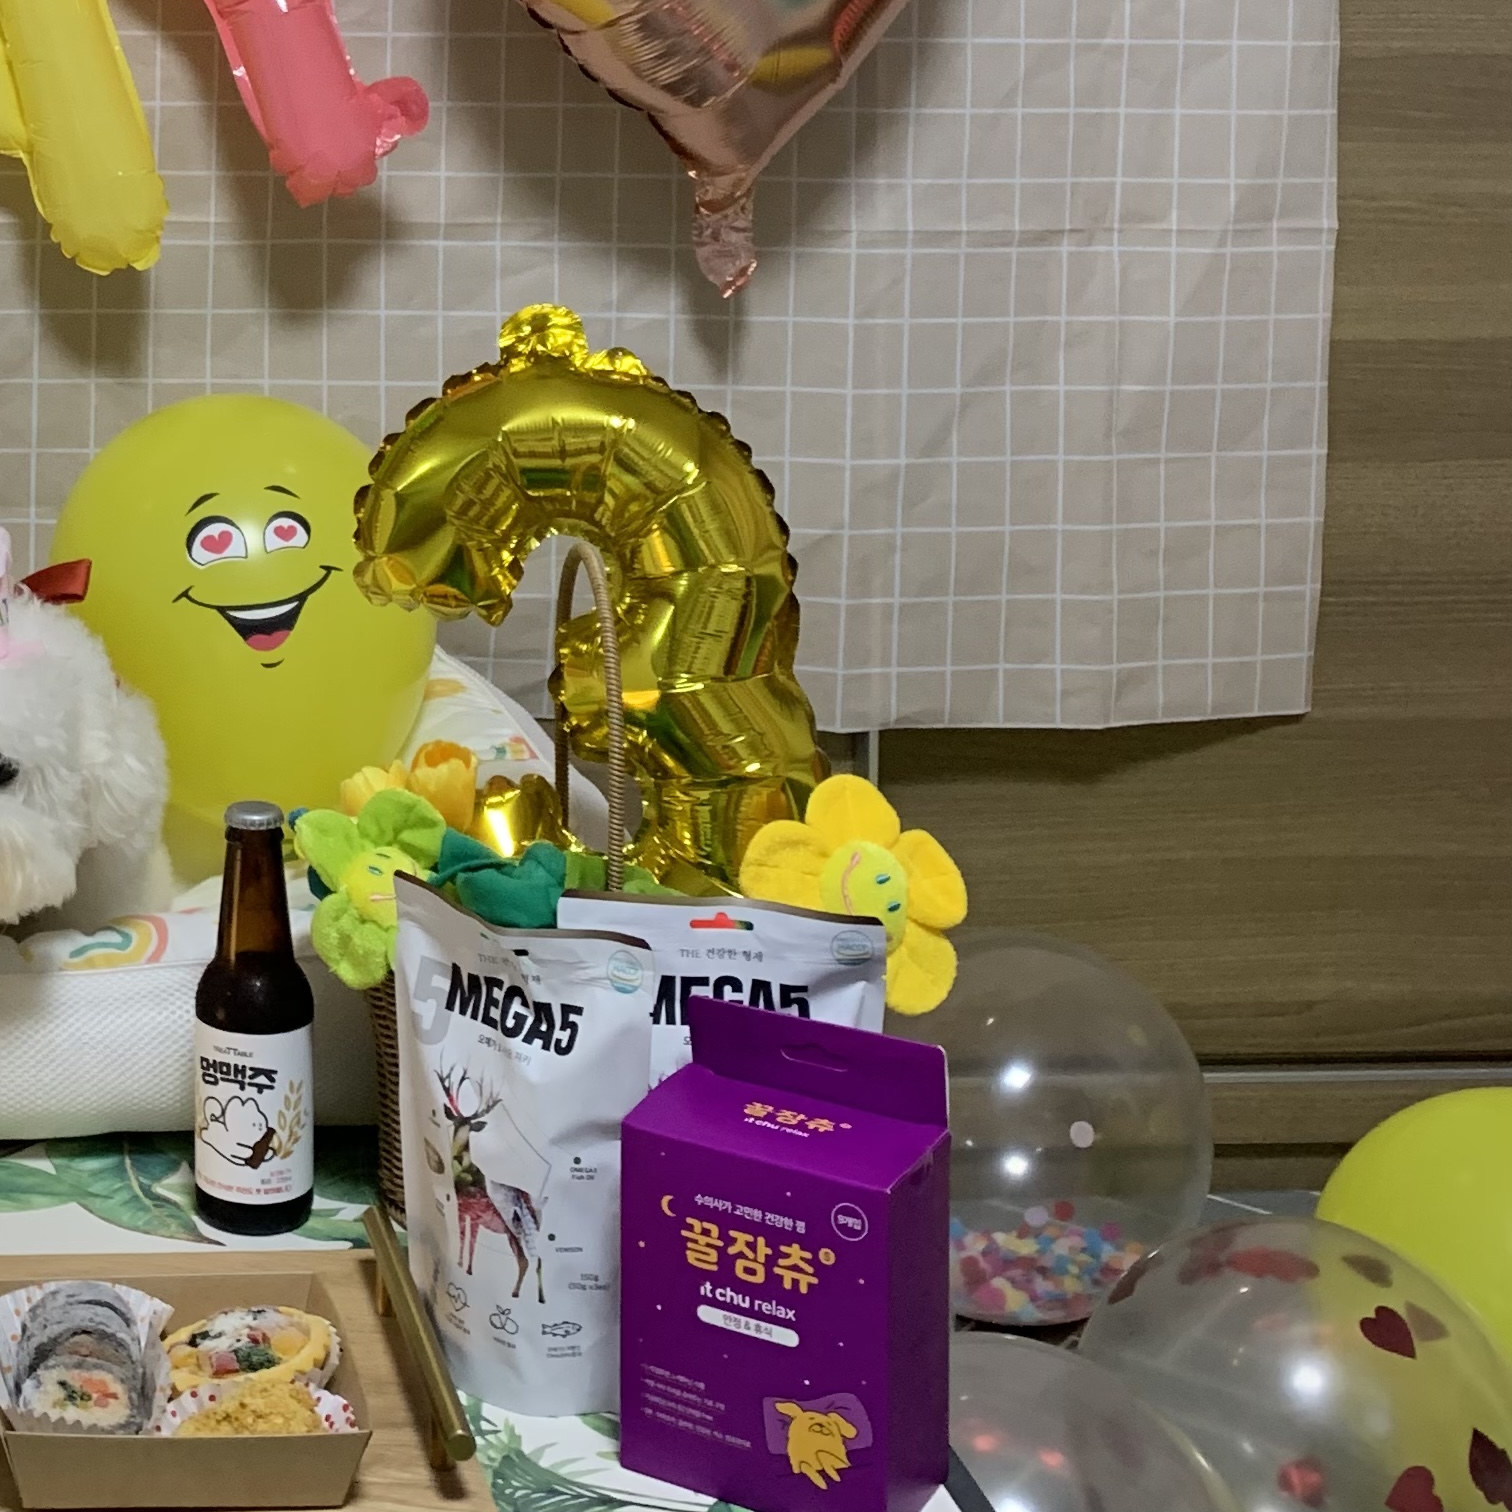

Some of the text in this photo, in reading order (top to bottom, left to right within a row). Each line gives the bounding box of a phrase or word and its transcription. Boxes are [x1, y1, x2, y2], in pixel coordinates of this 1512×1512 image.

[680, 948, 701, 959] THE
[705, 947, 737, 960] 건강한
[445, 962, 584, 1057] MEGA5
[200, 1055, 278, 1094] 멍맥주
[694, 1193, 732, 1214] 수의사가
[733, 1204, 763, 1222] 고민한
[764, 1211, 793, 1231] 건강한
[680, 1216, 819, 1294] 꿀잠츄
[699, 1281, 797, 1322] it chu relax
